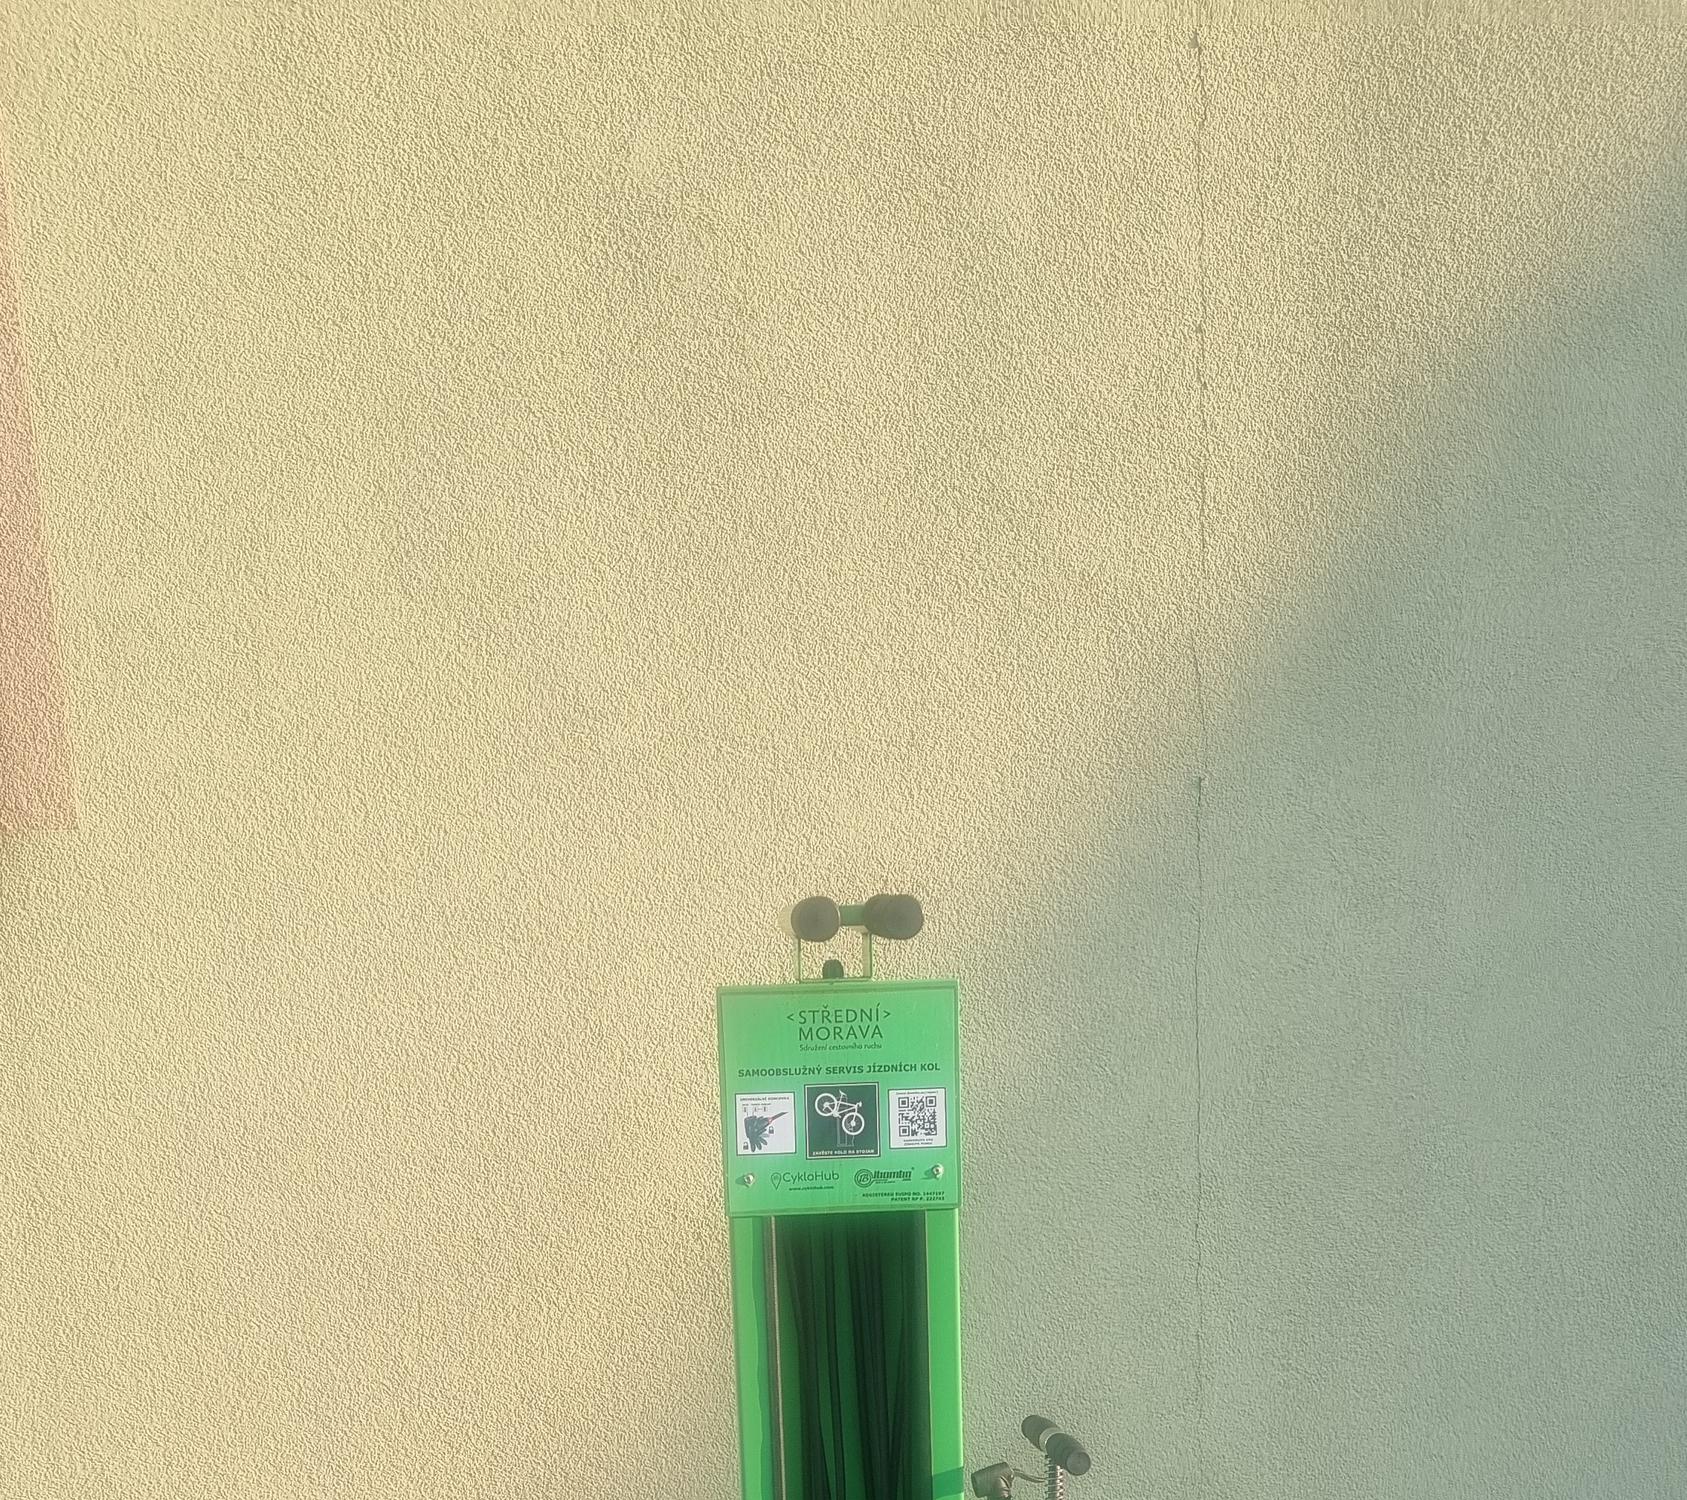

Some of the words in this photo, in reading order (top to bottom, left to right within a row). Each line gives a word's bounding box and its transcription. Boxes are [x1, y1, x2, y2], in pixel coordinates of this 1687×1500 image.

[799, 1025, 884, 1041] MORAVA
[799, 1043, 828, 1052] Sdružení
[829, 1041, 863, 1051] cestovního
[864, 1041, 882, 1050] ruchu
[738, 1065, 822, 1077] SAMOOBSLUŽNÝ
[825, 1065, 864, 1075] SERVIS
[866, 1062, 917, 1073] JÍZDNÍCH
[920, 1062, 941, 1072] KOL
[782, 1170, 840, 1185] CykloHub
